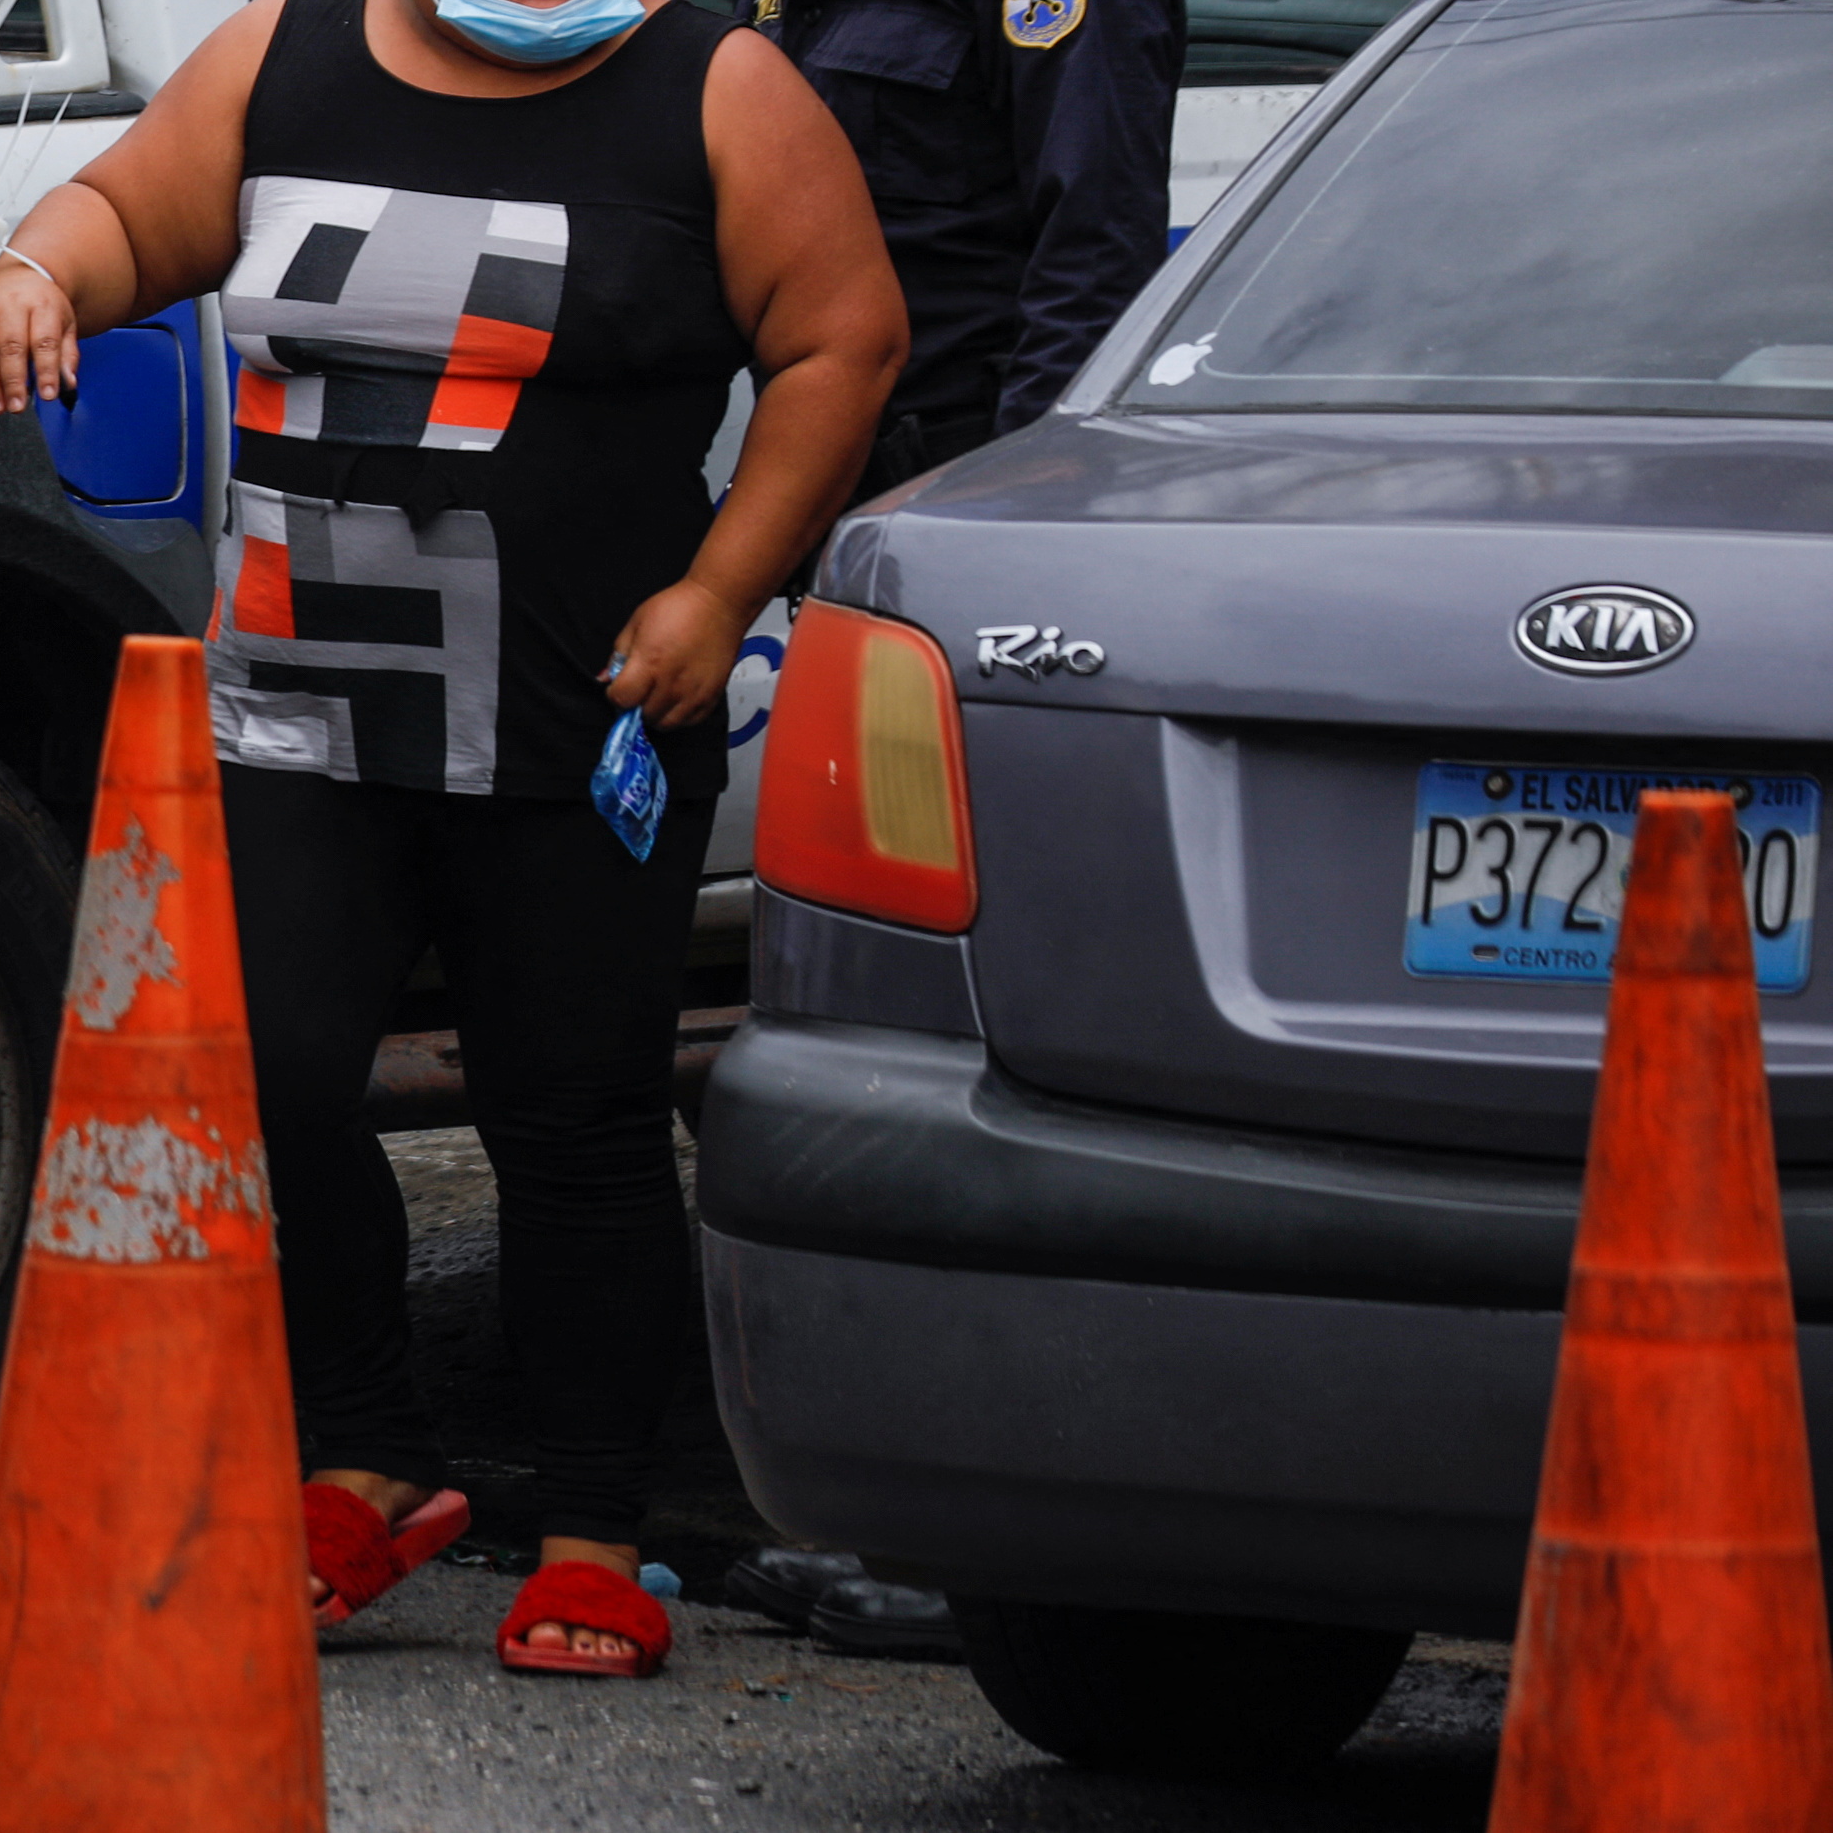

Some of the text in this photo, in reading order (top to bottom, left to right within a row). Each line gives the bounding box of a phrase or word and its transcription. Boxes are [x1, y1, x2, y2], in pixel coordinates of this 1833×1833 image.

[1545, 604, 1659, 654] KIA
[975, 624, 1105, 682] Rio
[1521, 773, 1555, 810] EL
[1503, 946, 1598, 970] CENTRO
